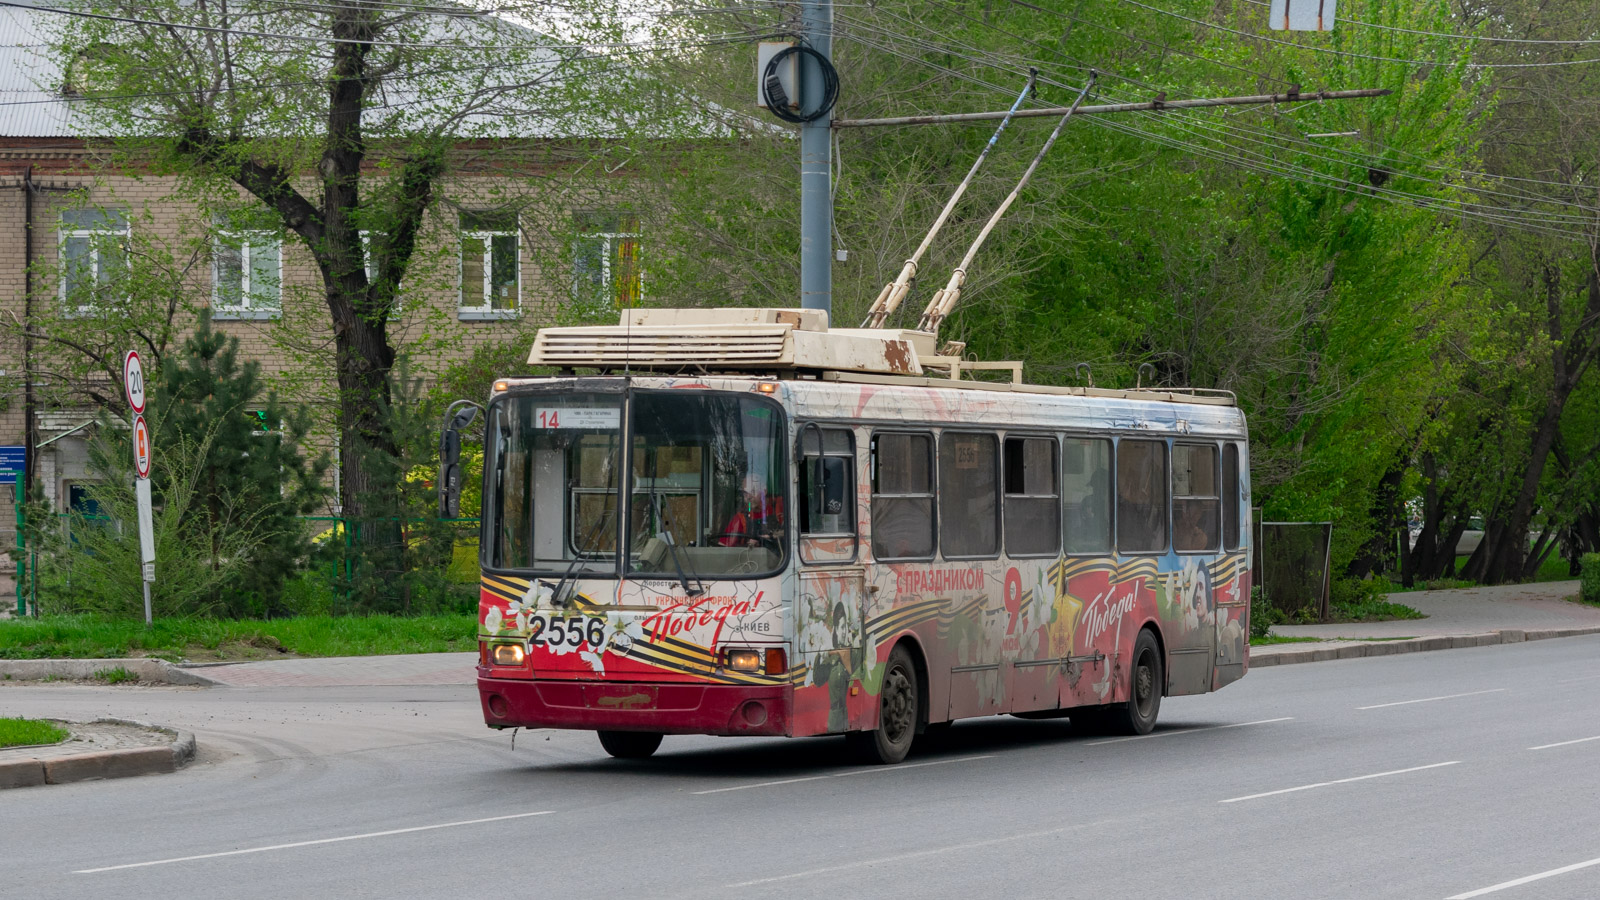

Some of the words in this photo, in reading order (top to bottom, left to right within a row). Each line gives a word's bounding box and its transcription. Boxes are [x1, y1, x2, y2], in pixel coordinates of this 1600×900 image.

[130, 370, 143, 395] 20
[539, 411, 559, 429] 14
[896, 571, 903, 593] С
[905, 568, 985, 596] ПРАЗДНИКОМ
[1004, 567, 1022, 635] 9
[529, 616, 605, 647] 2556
[641, 591, 764, 656] Победа!
[744, 622, 771, 632] КИЕВ
[1082, 580, 1139, 658] Победа!
